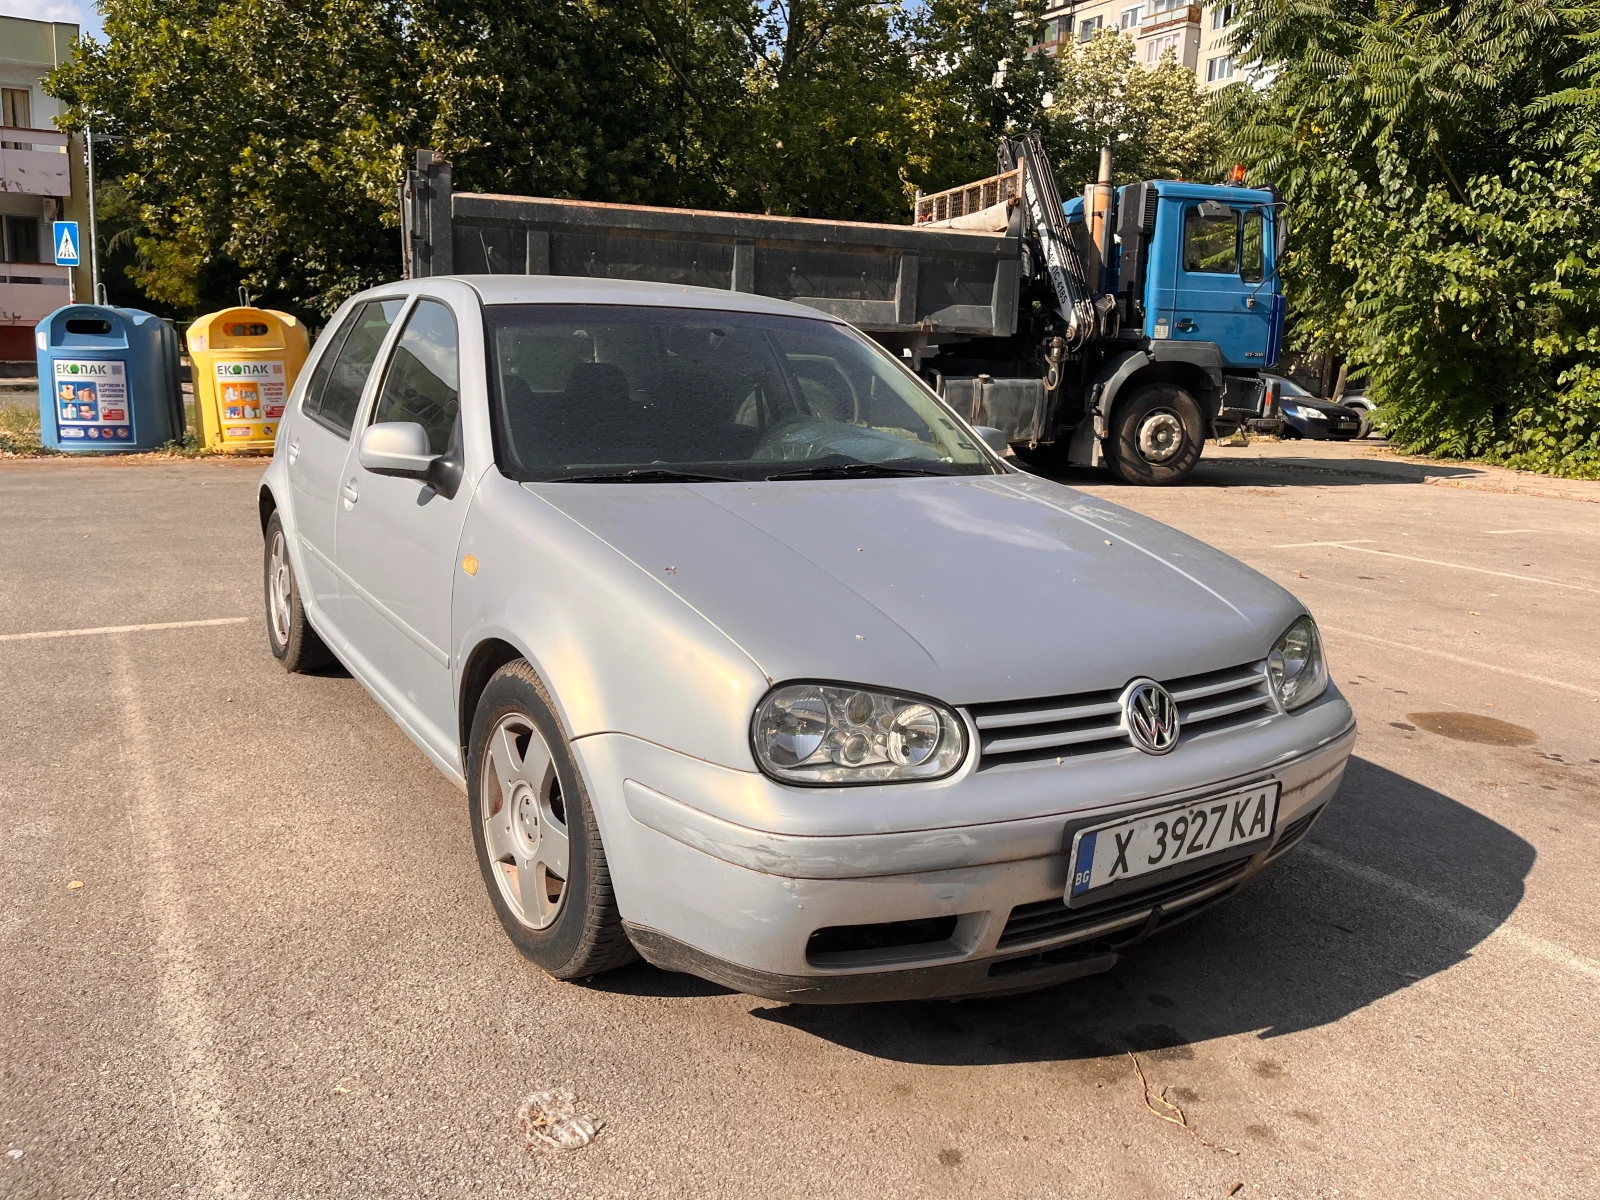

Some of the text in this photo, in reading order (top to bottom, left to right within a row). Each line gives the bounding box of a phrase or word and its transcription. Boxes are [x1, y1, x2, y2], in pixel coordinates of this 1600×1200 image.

[1031, 200, 1042, 225] 102
[1057, 282, 1068, 304] 4185
[56, 364, 107, 375] ЕКОПАК
[217, 364, 269, 375] ЕКОПАК
[1075, 870, 1090, 886] BG
[1148, 804, 1228, 865] 3927
